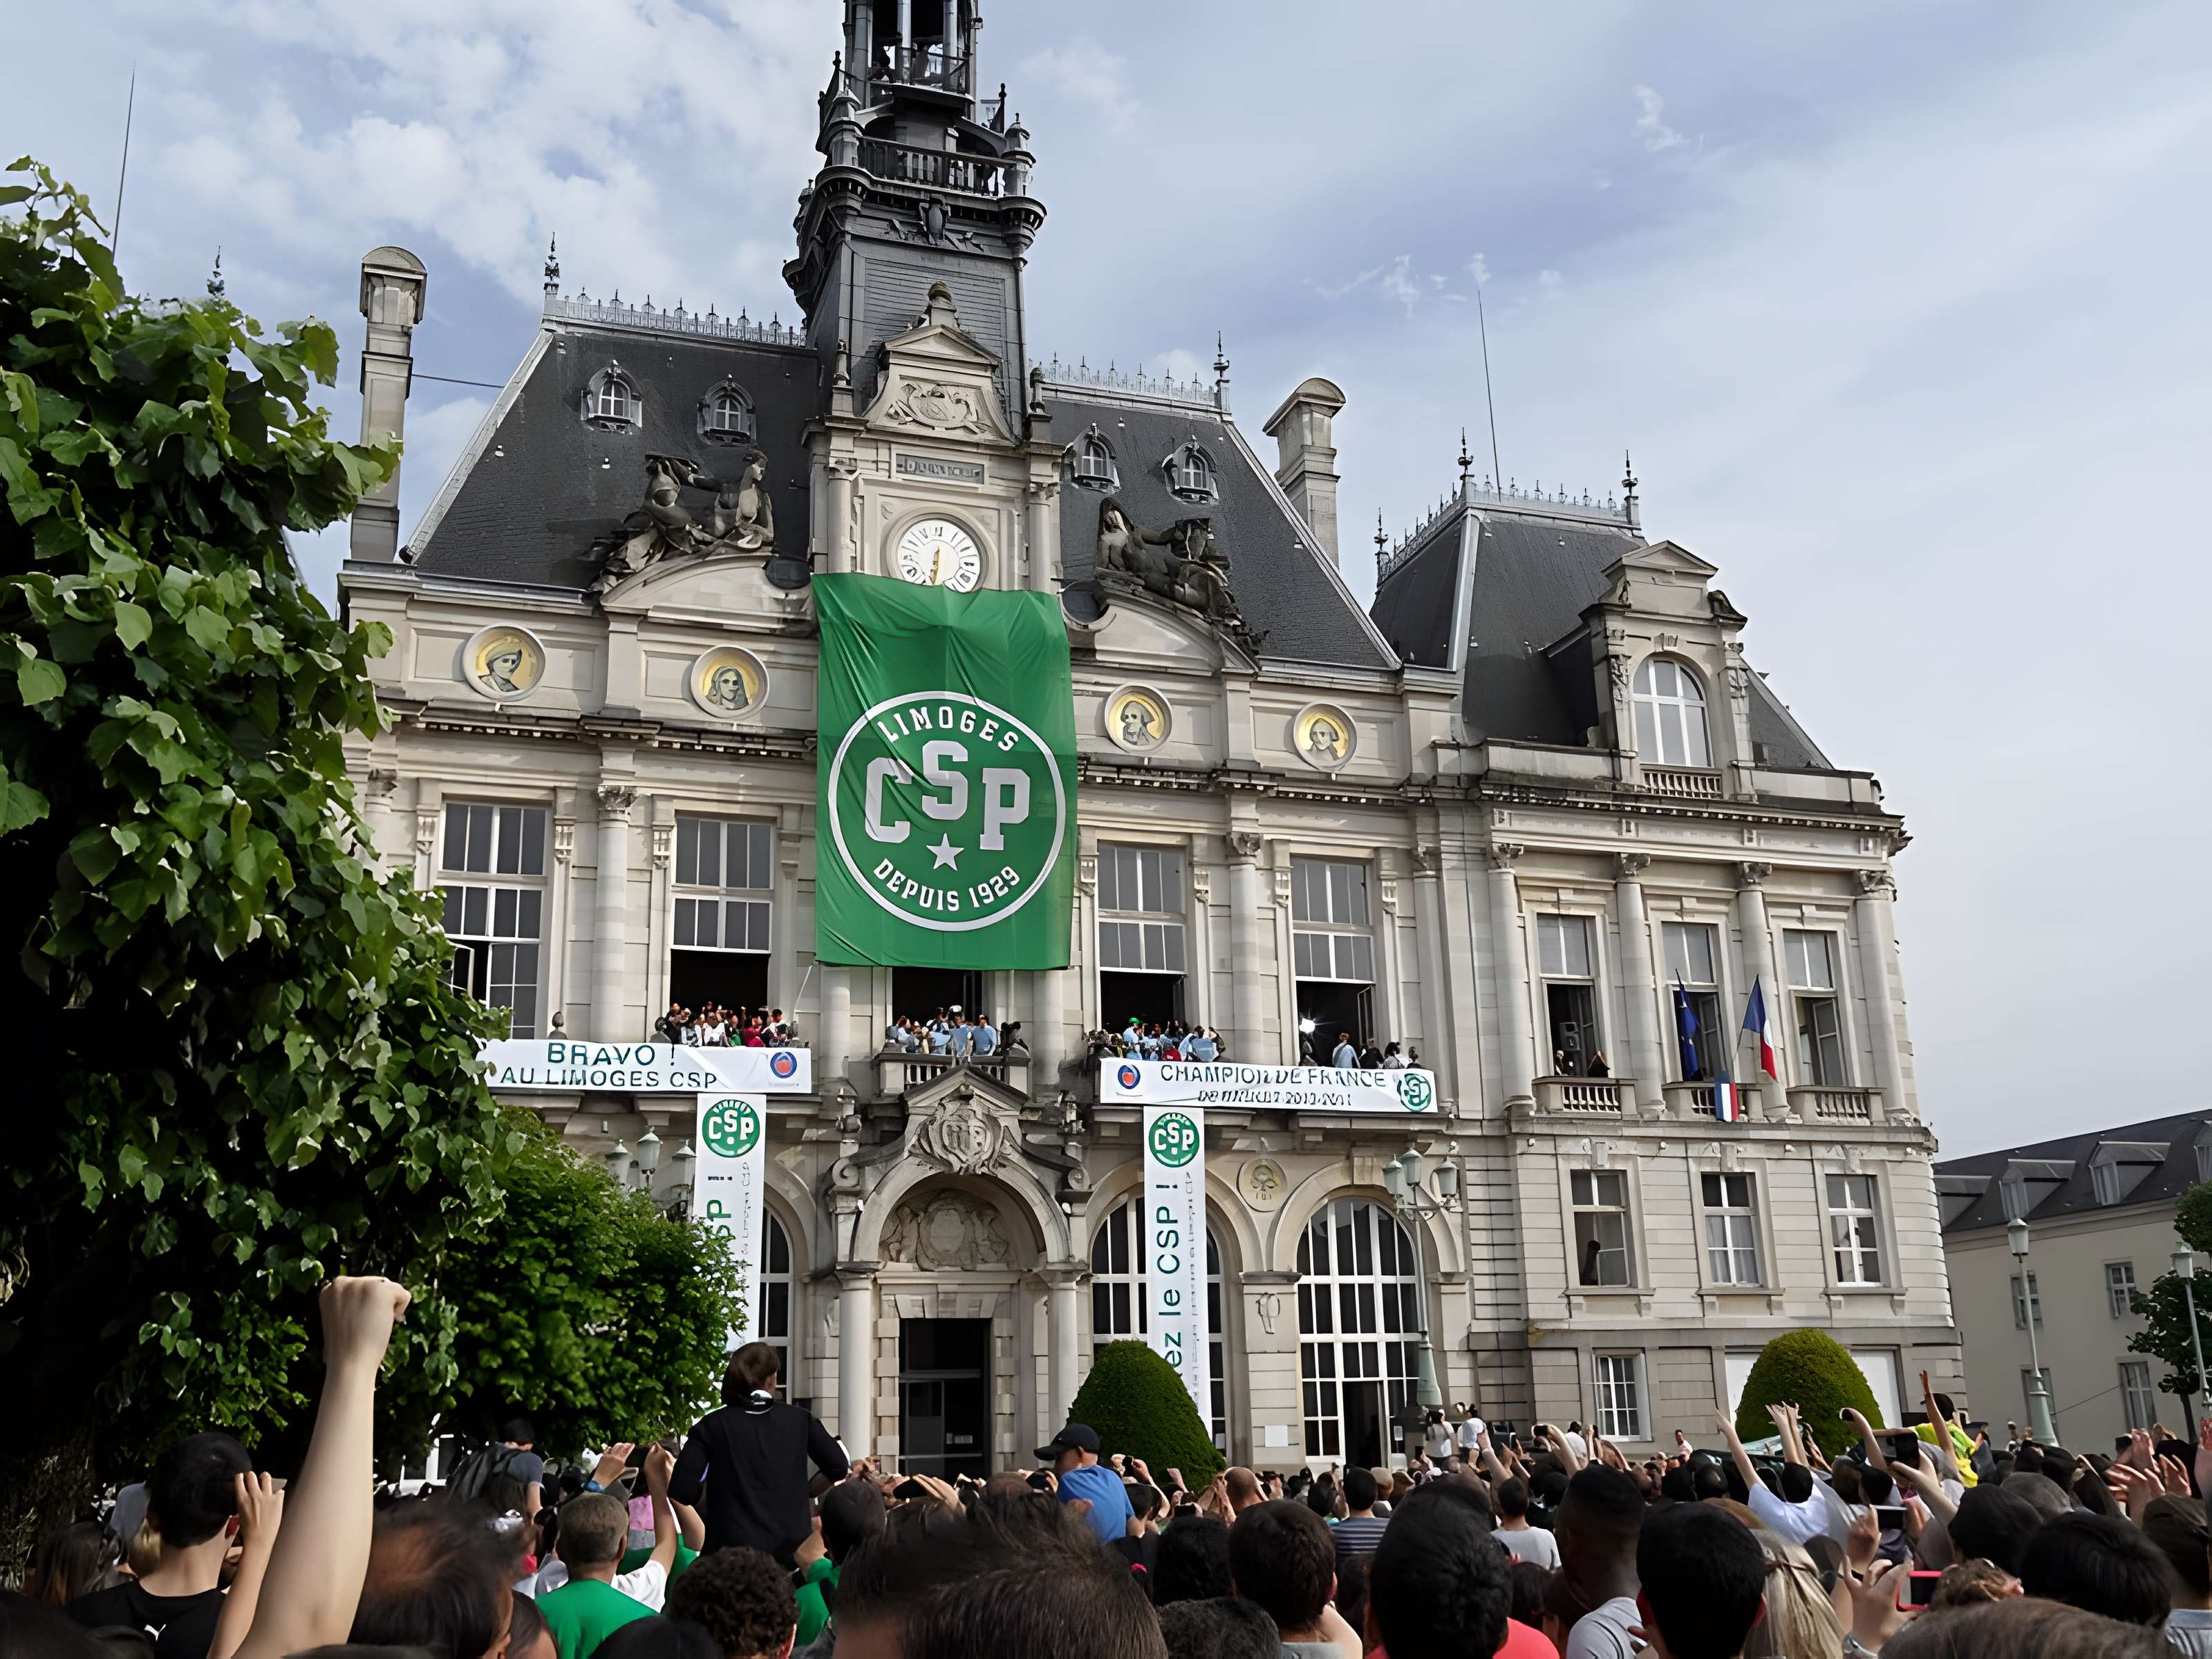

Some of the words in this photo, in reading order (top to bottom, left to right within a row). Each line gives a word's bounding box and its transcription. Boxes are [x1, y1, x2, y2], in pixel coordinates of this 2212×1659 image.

[877, 706, 1019, 751] LIMOGES
[864, 740, 1031, 852] CSP
[873, 857, 960, 912] DEPUIS
[968, 865, 1020, 908] 1929
[547, 1042, 655, 1067] BRAVO
[500, 1067, 534, 1084] AU
[545, 1069, 659, 1087] LIMOGES
[669, 1071, 717, 1089] CSP
[1308, 1068, 1387, 1087] FRANCE
[709, 1109, 754, 1141] CSP
[1154, 1121, 1195, 1151] CSP
[1156, 1206, 1181, 1275] CSP
[1159, 1288, 1181, 1316] le
